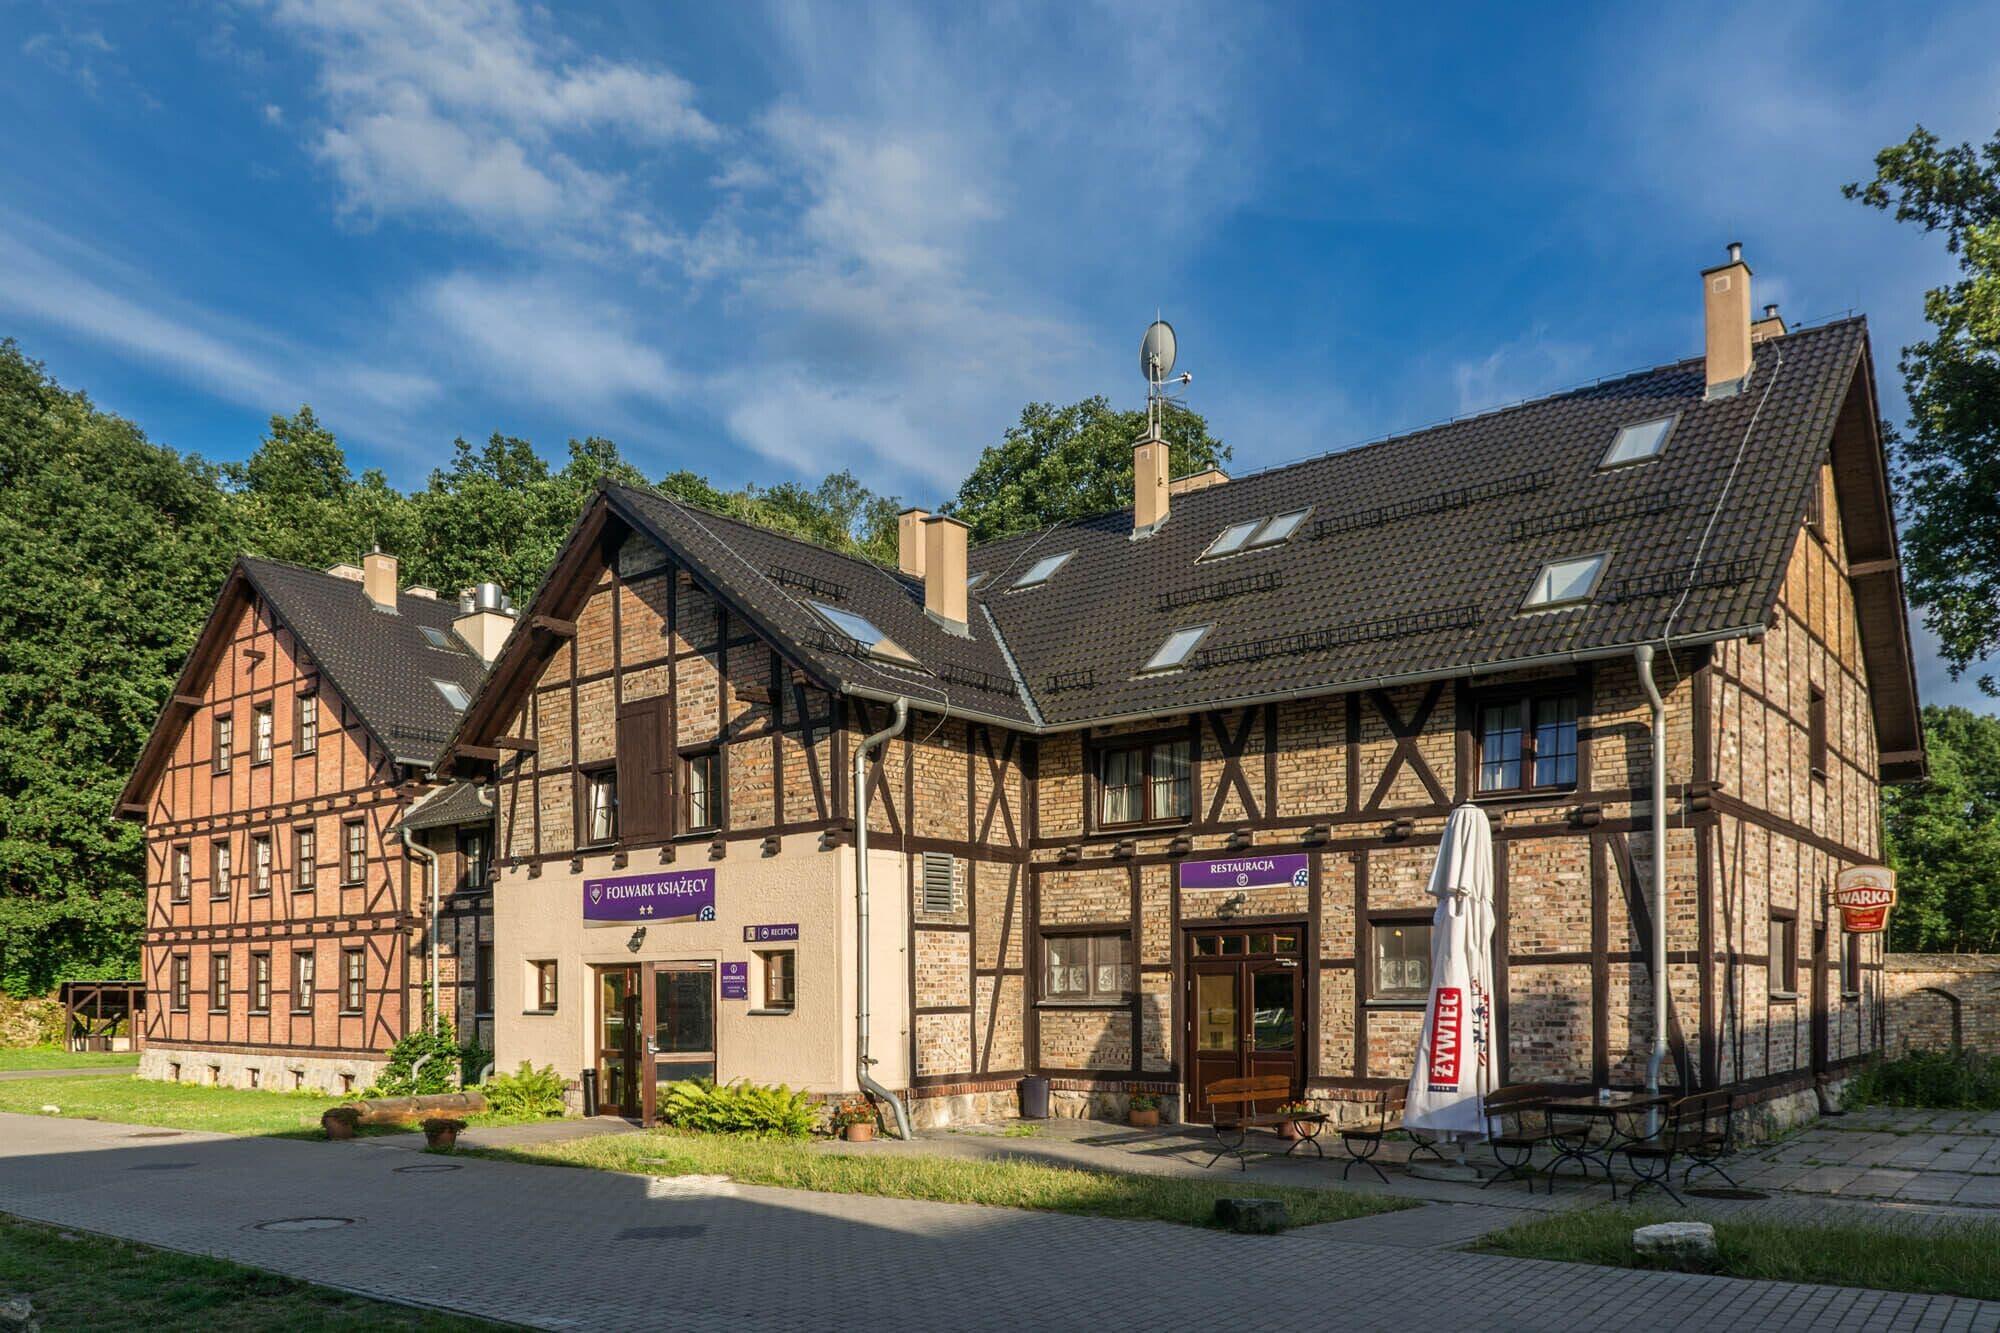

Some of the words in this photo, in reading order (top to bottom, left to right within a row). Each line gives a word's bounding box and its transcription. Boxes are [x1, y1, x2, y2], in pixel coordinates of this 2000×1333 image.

[1210, 860, 1275, 874] RESTAURACJA
[606, 883, 655, 900] FOLWARK
[657, 876, 708, 898] KSIĄŻĘCY
[1838, 890, 1890, 905] WARKA
[1431, 993, 1459, 1078] ŻYWIEC
